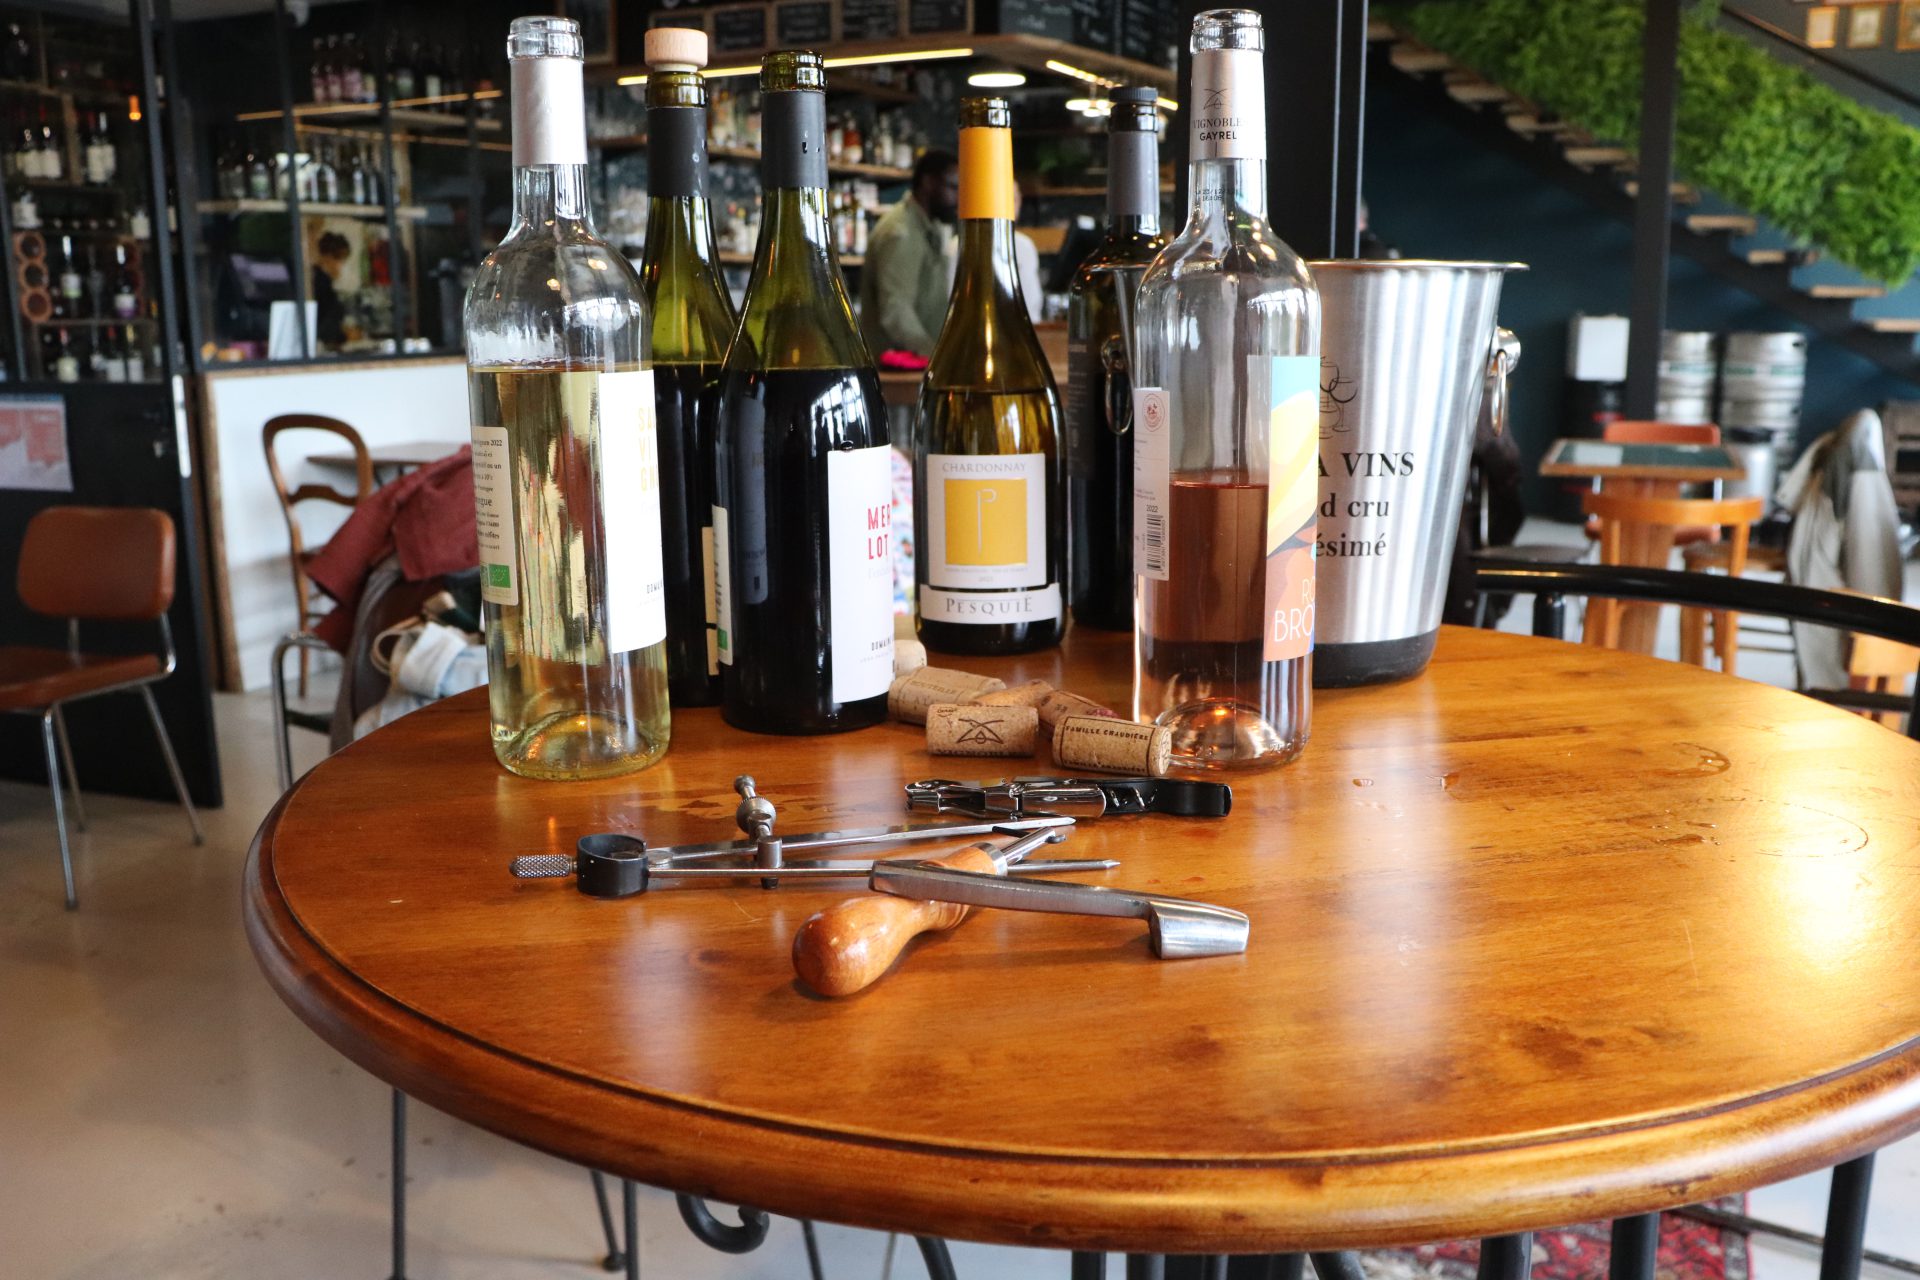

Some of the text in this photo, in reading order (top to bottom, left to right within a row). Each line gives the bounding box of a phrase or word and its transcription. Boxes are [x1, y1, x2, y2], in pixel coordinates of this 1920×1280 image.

[1199, 130, 1237, 141] GAYREL
[490, 439, 503, 447] 2022
[942, 462, 1026, 473] CHARDONNAY
[1341, 451, 1415, 477] VINS
[1146, 504, 1159, 513] 2022
[1347, 500, 1389, 518] cru
[868, 534, 888, 560] LOT
[946, 594, 1033, 615] PESQUIÉ
[1065, 725, 1100, 735] FAMILLE
